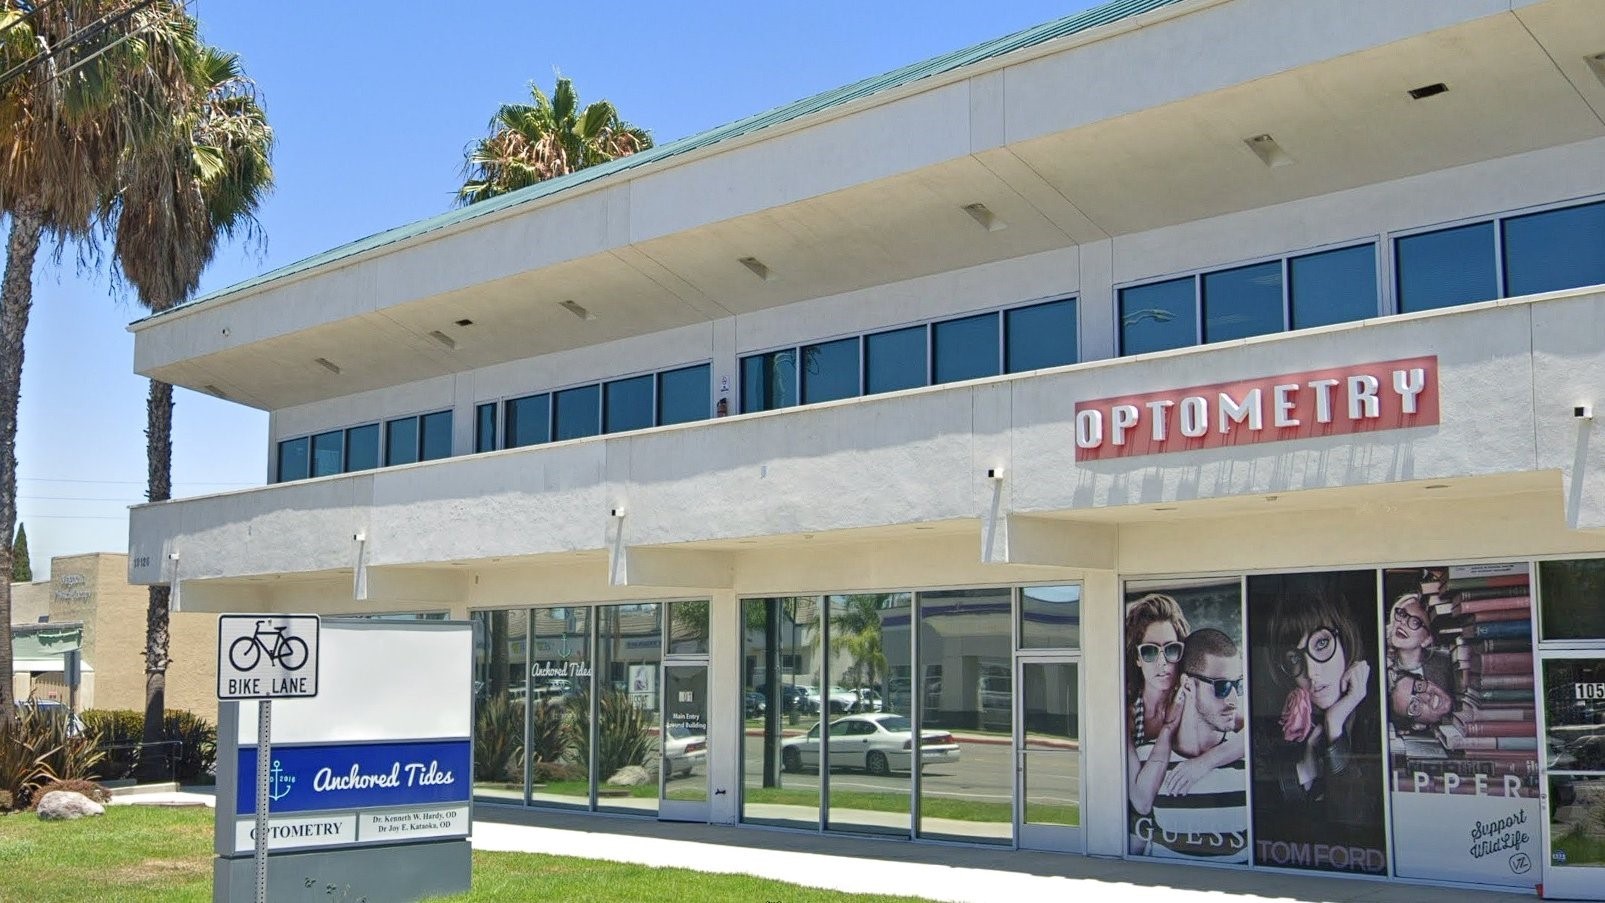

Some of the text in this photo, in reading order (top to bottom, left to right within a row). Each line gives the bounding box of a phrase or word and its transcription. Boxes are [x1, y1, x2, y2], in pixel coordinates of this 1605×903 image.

[1075, 368, 1425, 449] OPTOMETRY
[531, 661, 592, 677] Anchored Tides
[228, 677, 307, 695] BIKE LANE
[1578, 683, 1604, 698] 105
[686, 713, 700, 721] Entry
[313, 760, 455, 792] Anchored Tides
[372, 815, 383, 823] Dr.
[384, 814, 412, 823] Kenneth
[423, 812, 445, 821] Hardy,
[445, 811, 457, 819] OD
[1471, 808, 1528, 842] Support
[250, 822, 342, 841] OTOMETRY
[378, 825, 387, 833] Dr
[389, 824, 400, 833] Joy
[410, 821, 438, 831] Kataoka,
